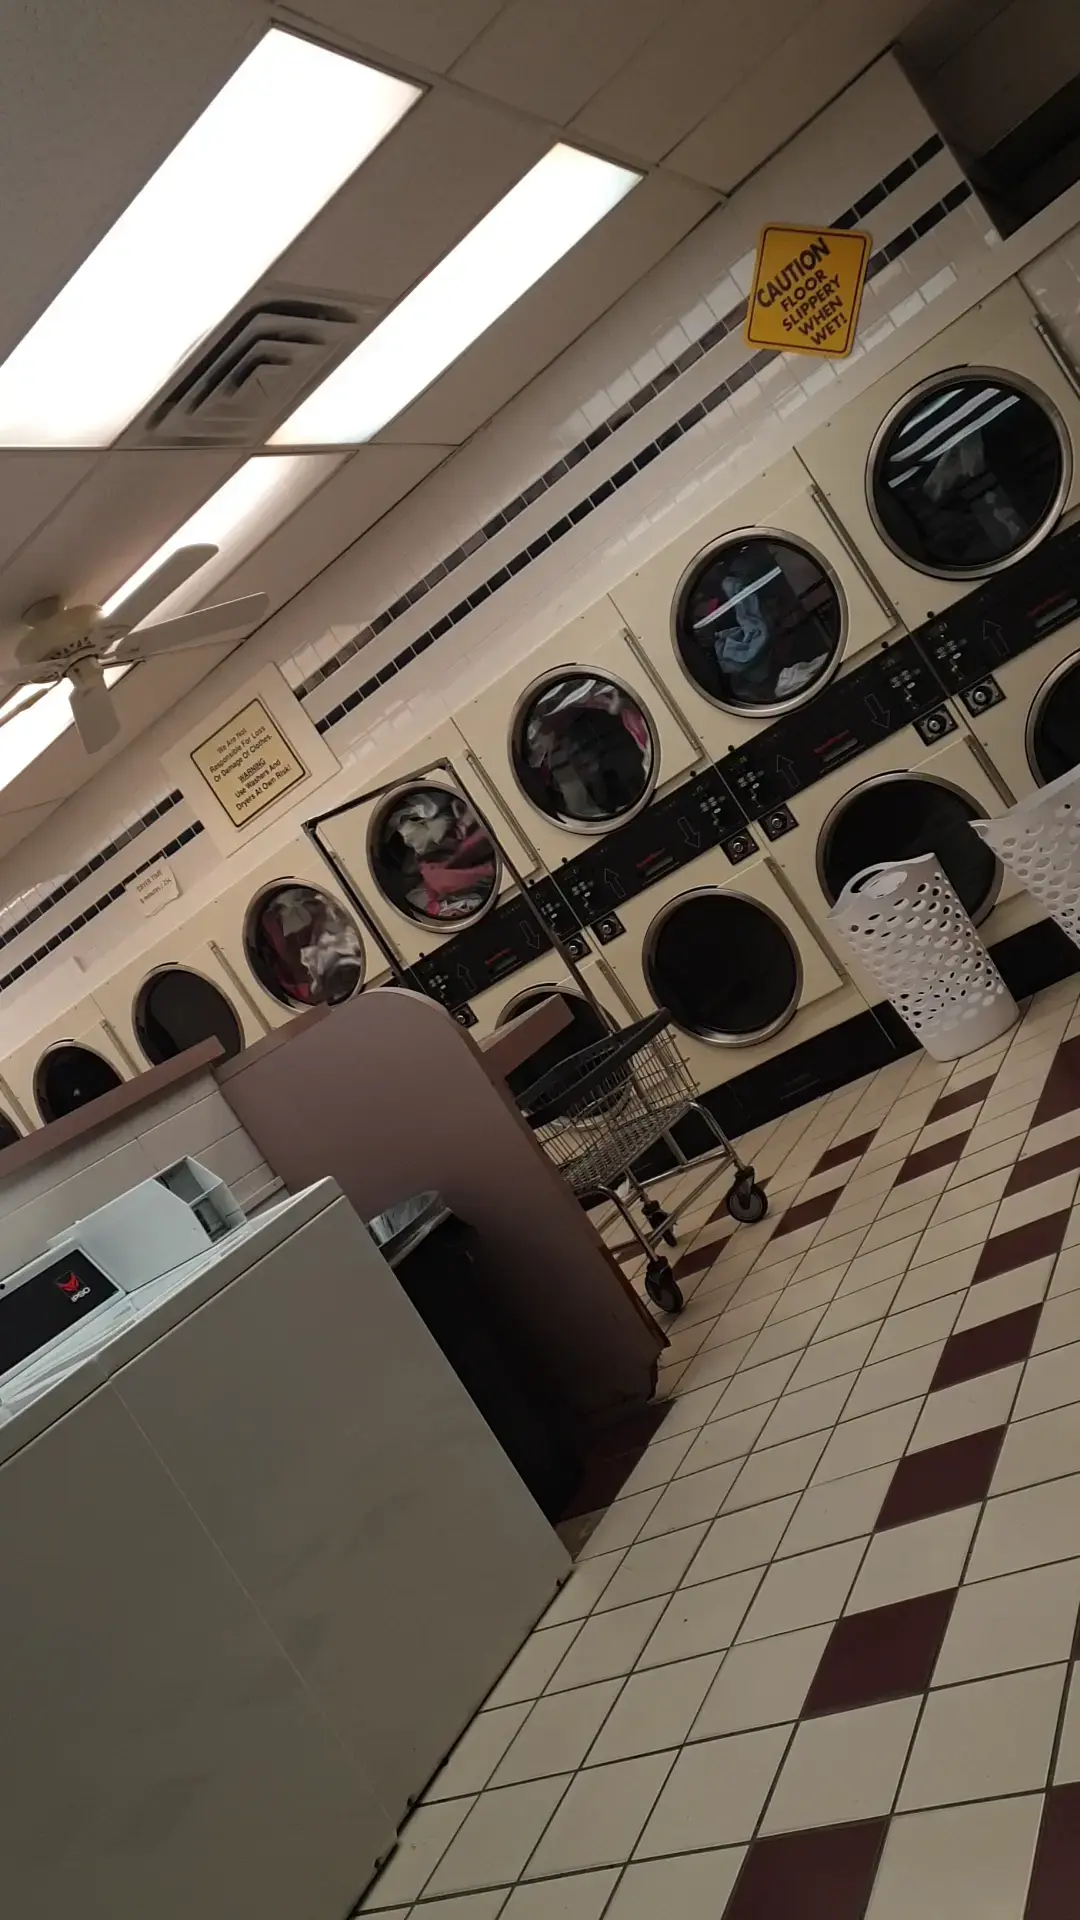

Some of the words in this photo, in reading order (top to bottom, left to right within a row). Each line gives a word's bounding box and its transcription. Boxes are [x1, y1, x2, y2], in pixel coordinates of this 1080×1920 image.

[757, 237, 831, 307] CAUTION
[781, 269, 828, 312] FLOOR
[782, 274, 840, 331] SLIPPERY
[798, 295, 843, 335] WHEN
[810, 312, 848, 345] WET!
[209, 745, 242, 773] Responsible
[241, 737, 252, 748] For
[251, 726, 266, 739] Loss
[213, 774, 222, 783] Or
[221, 757, 243, 777] Damage
[242, 750, 251, 759] Of
[249, 735, 273, 753] Clothes.
[217, 744, 228, 754] We
[226, 737, 237, 746] Are
[235, 728, 247, 739] Not
[234, 787, 247, 798] Use
[245, 769, 270, 789] Washers
[268, 759, 281, 772] And
[236, 795, 256, 811] Dryers
[255, 787, 264, 796] At
[261, 777, 276, 790] Own
[275, 764, 292, 780] Risk!
[237, 757, 267, 783] WARNING
[70, 1287, 91, 1302] IPSO
